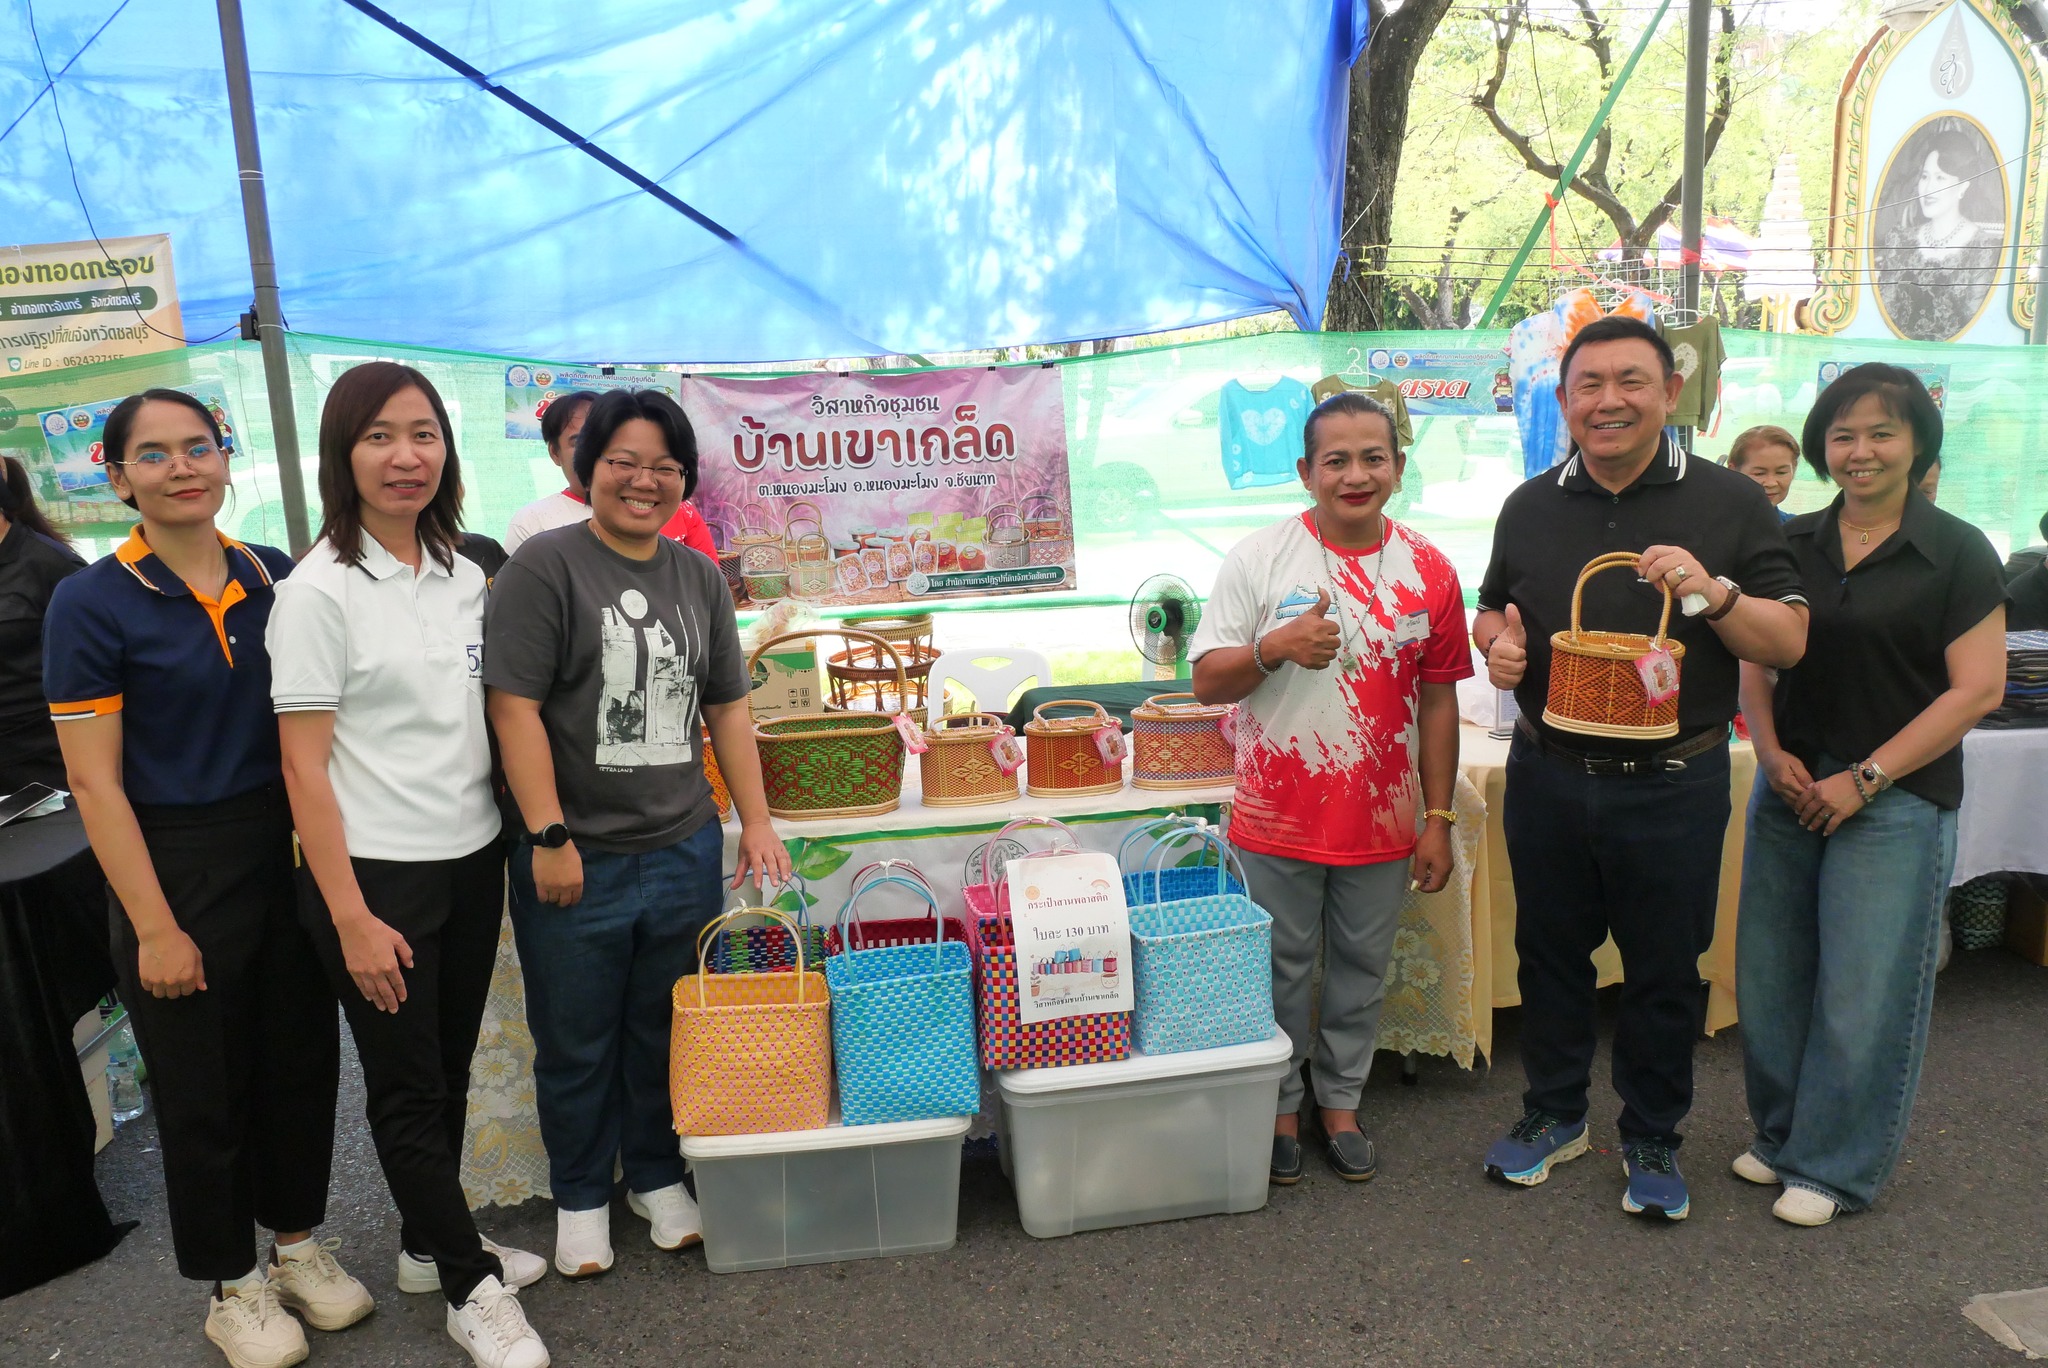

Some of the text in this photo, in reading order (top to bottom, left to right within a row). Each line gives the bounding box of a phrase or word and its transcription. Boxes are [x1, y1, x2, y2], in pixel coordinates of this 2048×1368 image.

[0, 256, 155, 285] องทอดกรอบ
[11, 298, 83, 315] อำเภอเกาะจันทร์
[24, 359, 39, 369] Line
[43, 358, 51, 367] ID
[1397, 379, 1470, 398] ตราด
[812, 395, 940, 419] วิสาหกิจชุมชน
[732, 403, 1017, 471] บ้านเขาเกล็ด
[758, 472, 996, 497] ต.หนองมะโมง อ.หนองมะโมง จ.ชัยนาท
[1027, 892, 1109, 910] กระเป๋าสานพลาสติก
[1033, 924, 1109, 942] ใบละ 130 บาท
